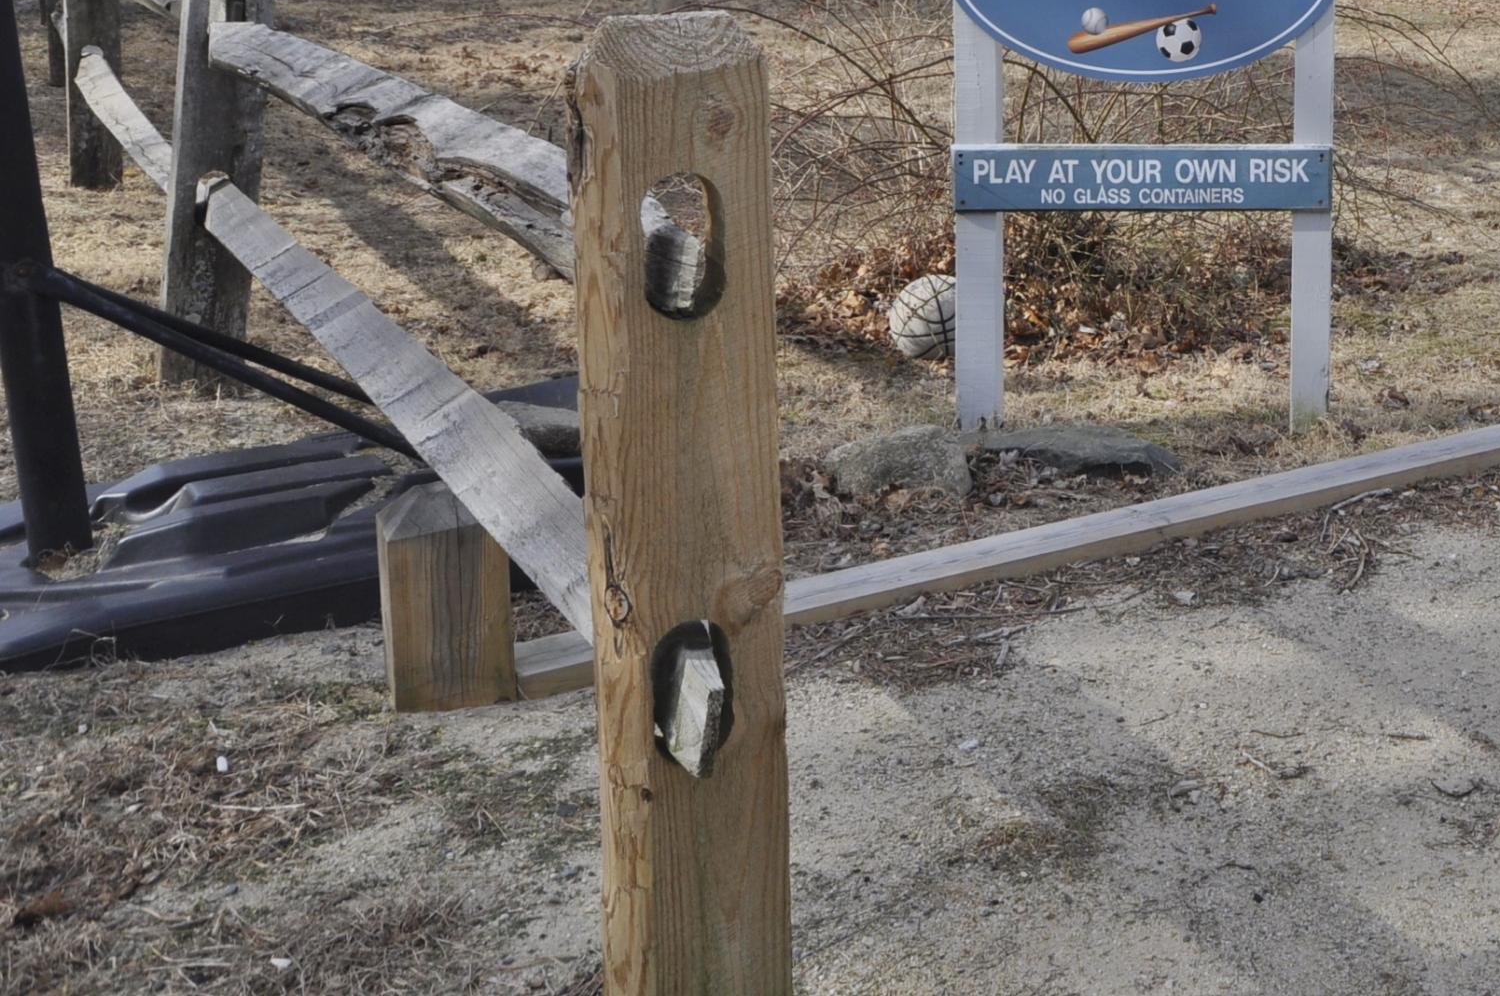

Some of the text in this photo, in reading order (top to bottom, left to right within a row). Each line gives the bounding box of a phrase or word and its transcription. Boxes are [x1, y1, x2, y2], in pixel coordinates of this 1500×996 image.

[973, 158, 1310, 184] PLAY AT YOUR OWN RISK
[1041, 187, 1244, 204] NO GLASS CONTAINERS
